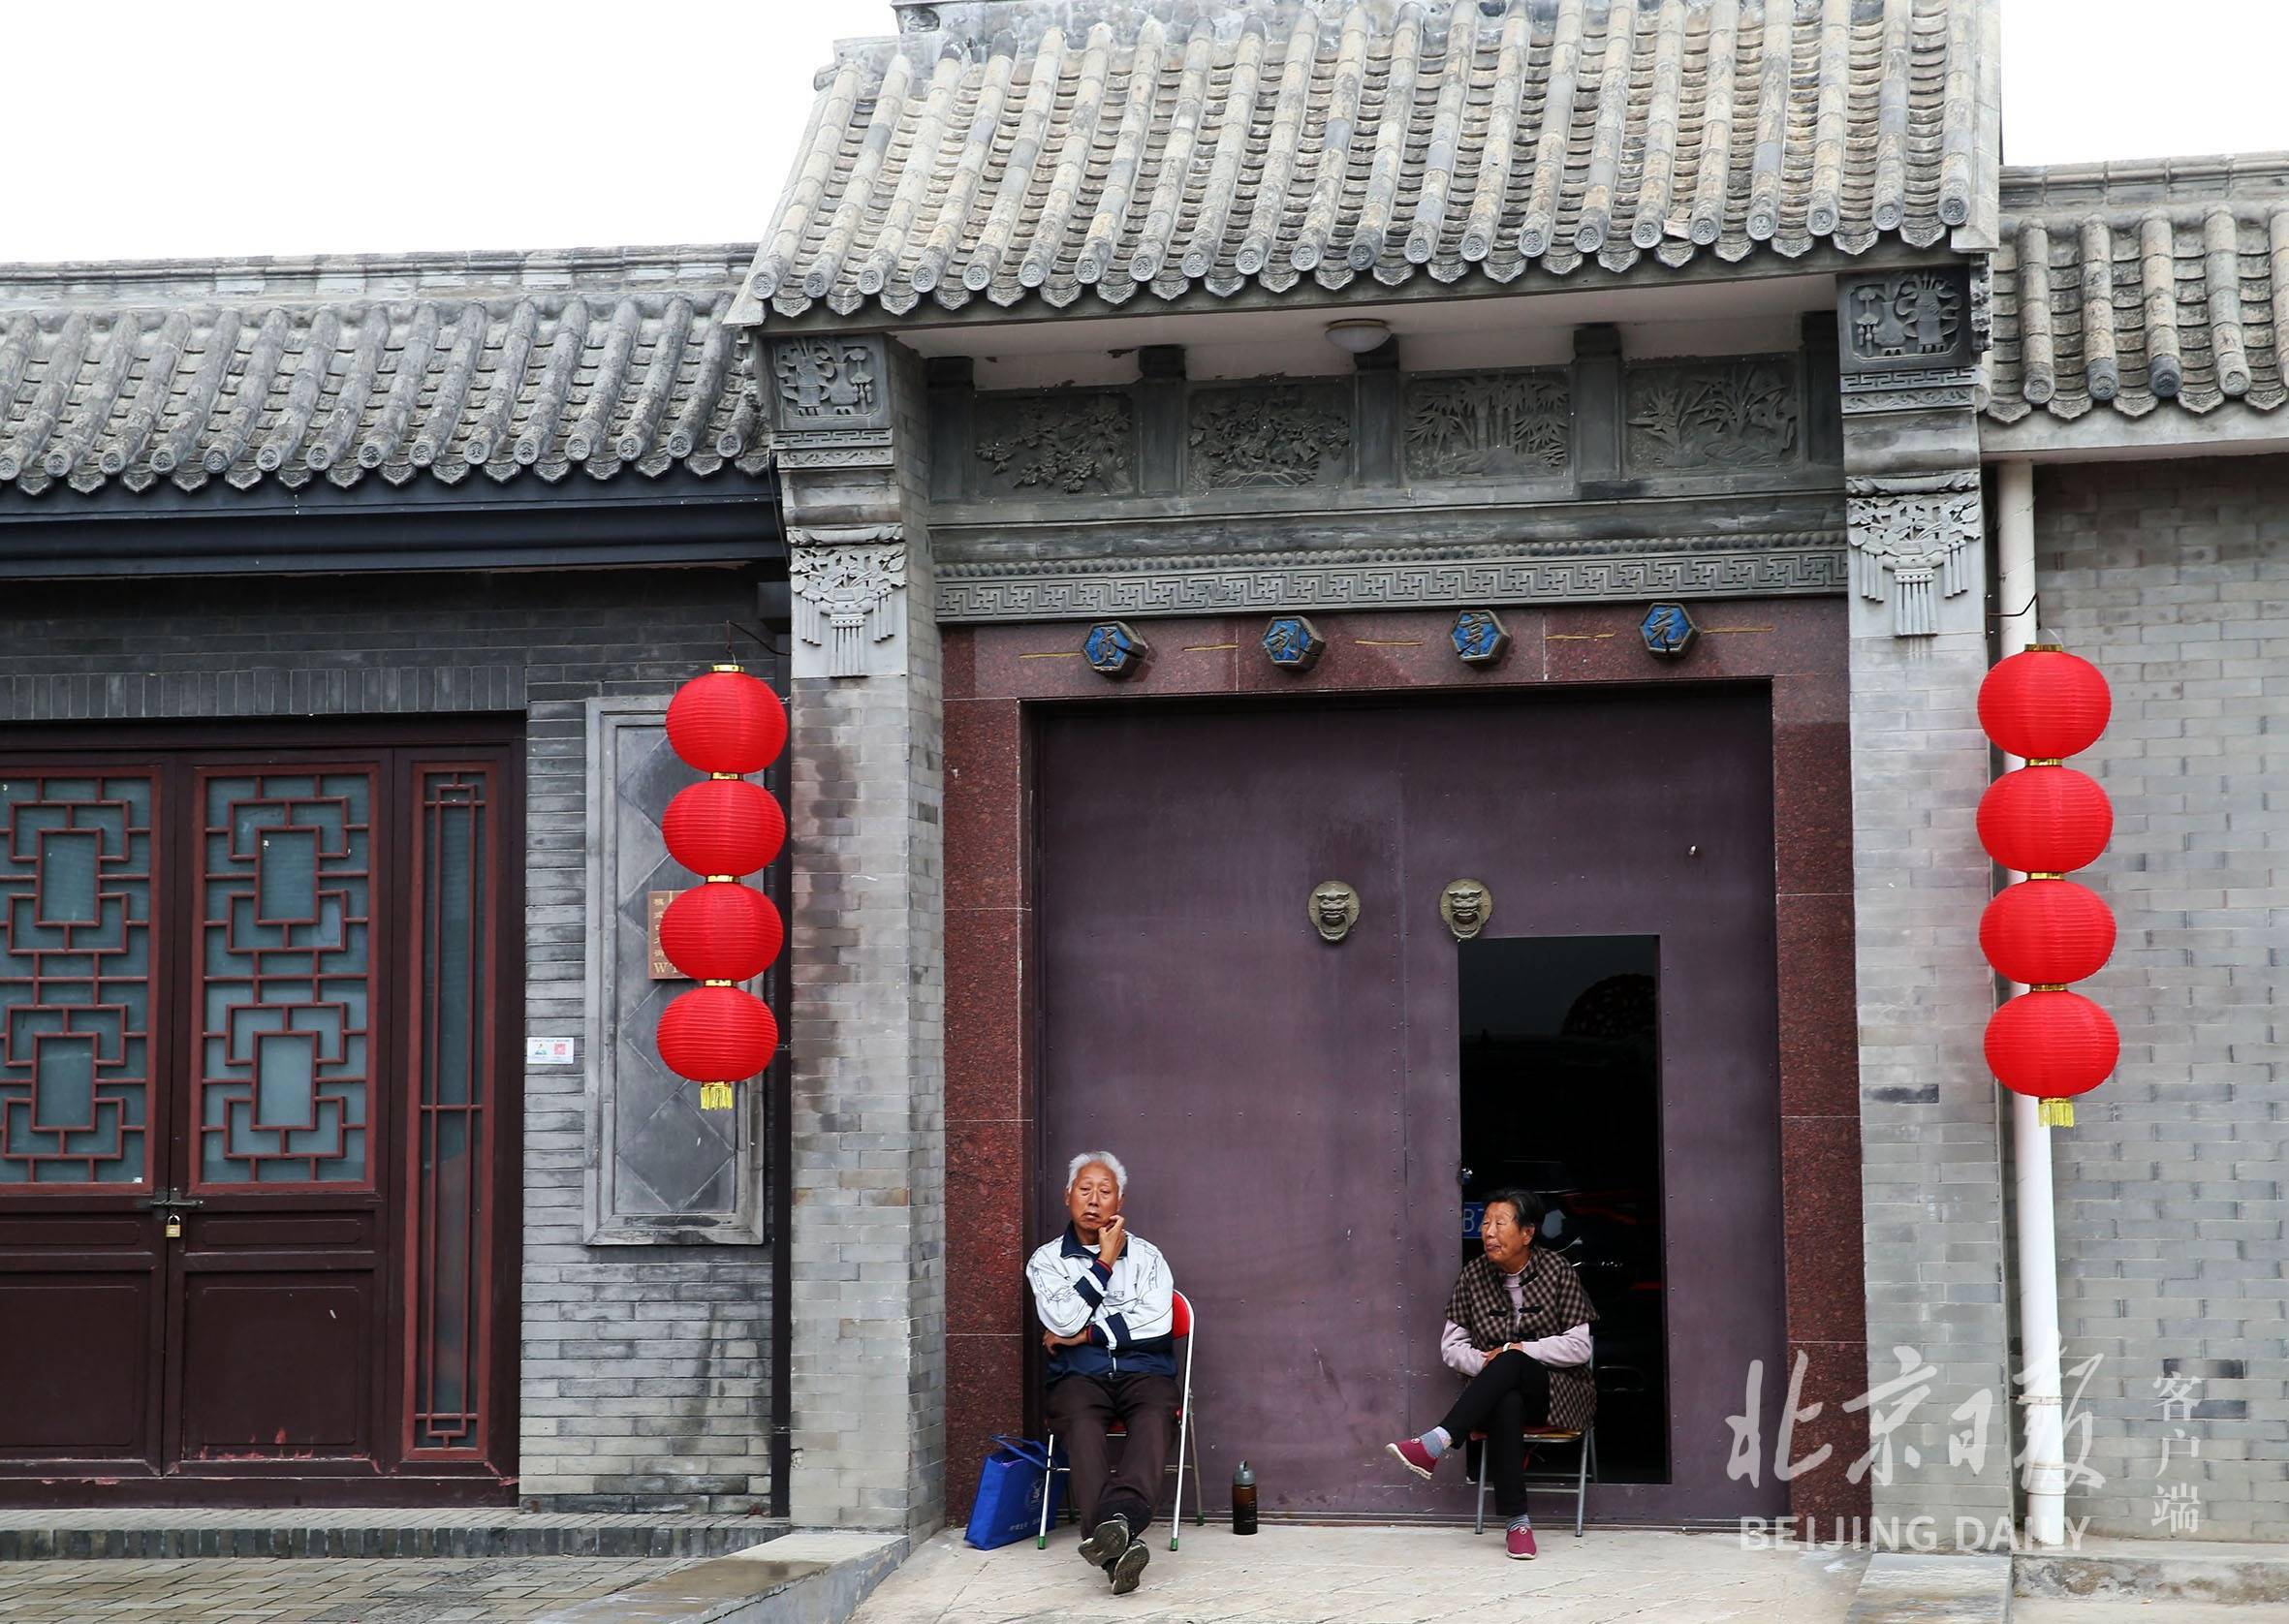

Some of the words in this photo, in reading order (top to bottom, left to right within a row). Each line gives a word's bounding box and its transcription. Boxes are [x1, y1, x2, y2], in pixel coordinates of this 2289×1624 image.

[1266, 622, 1301, 661] 利
[1458, 612, 1490, 656] 亨
[1647, 609, 1684, 649] 元
